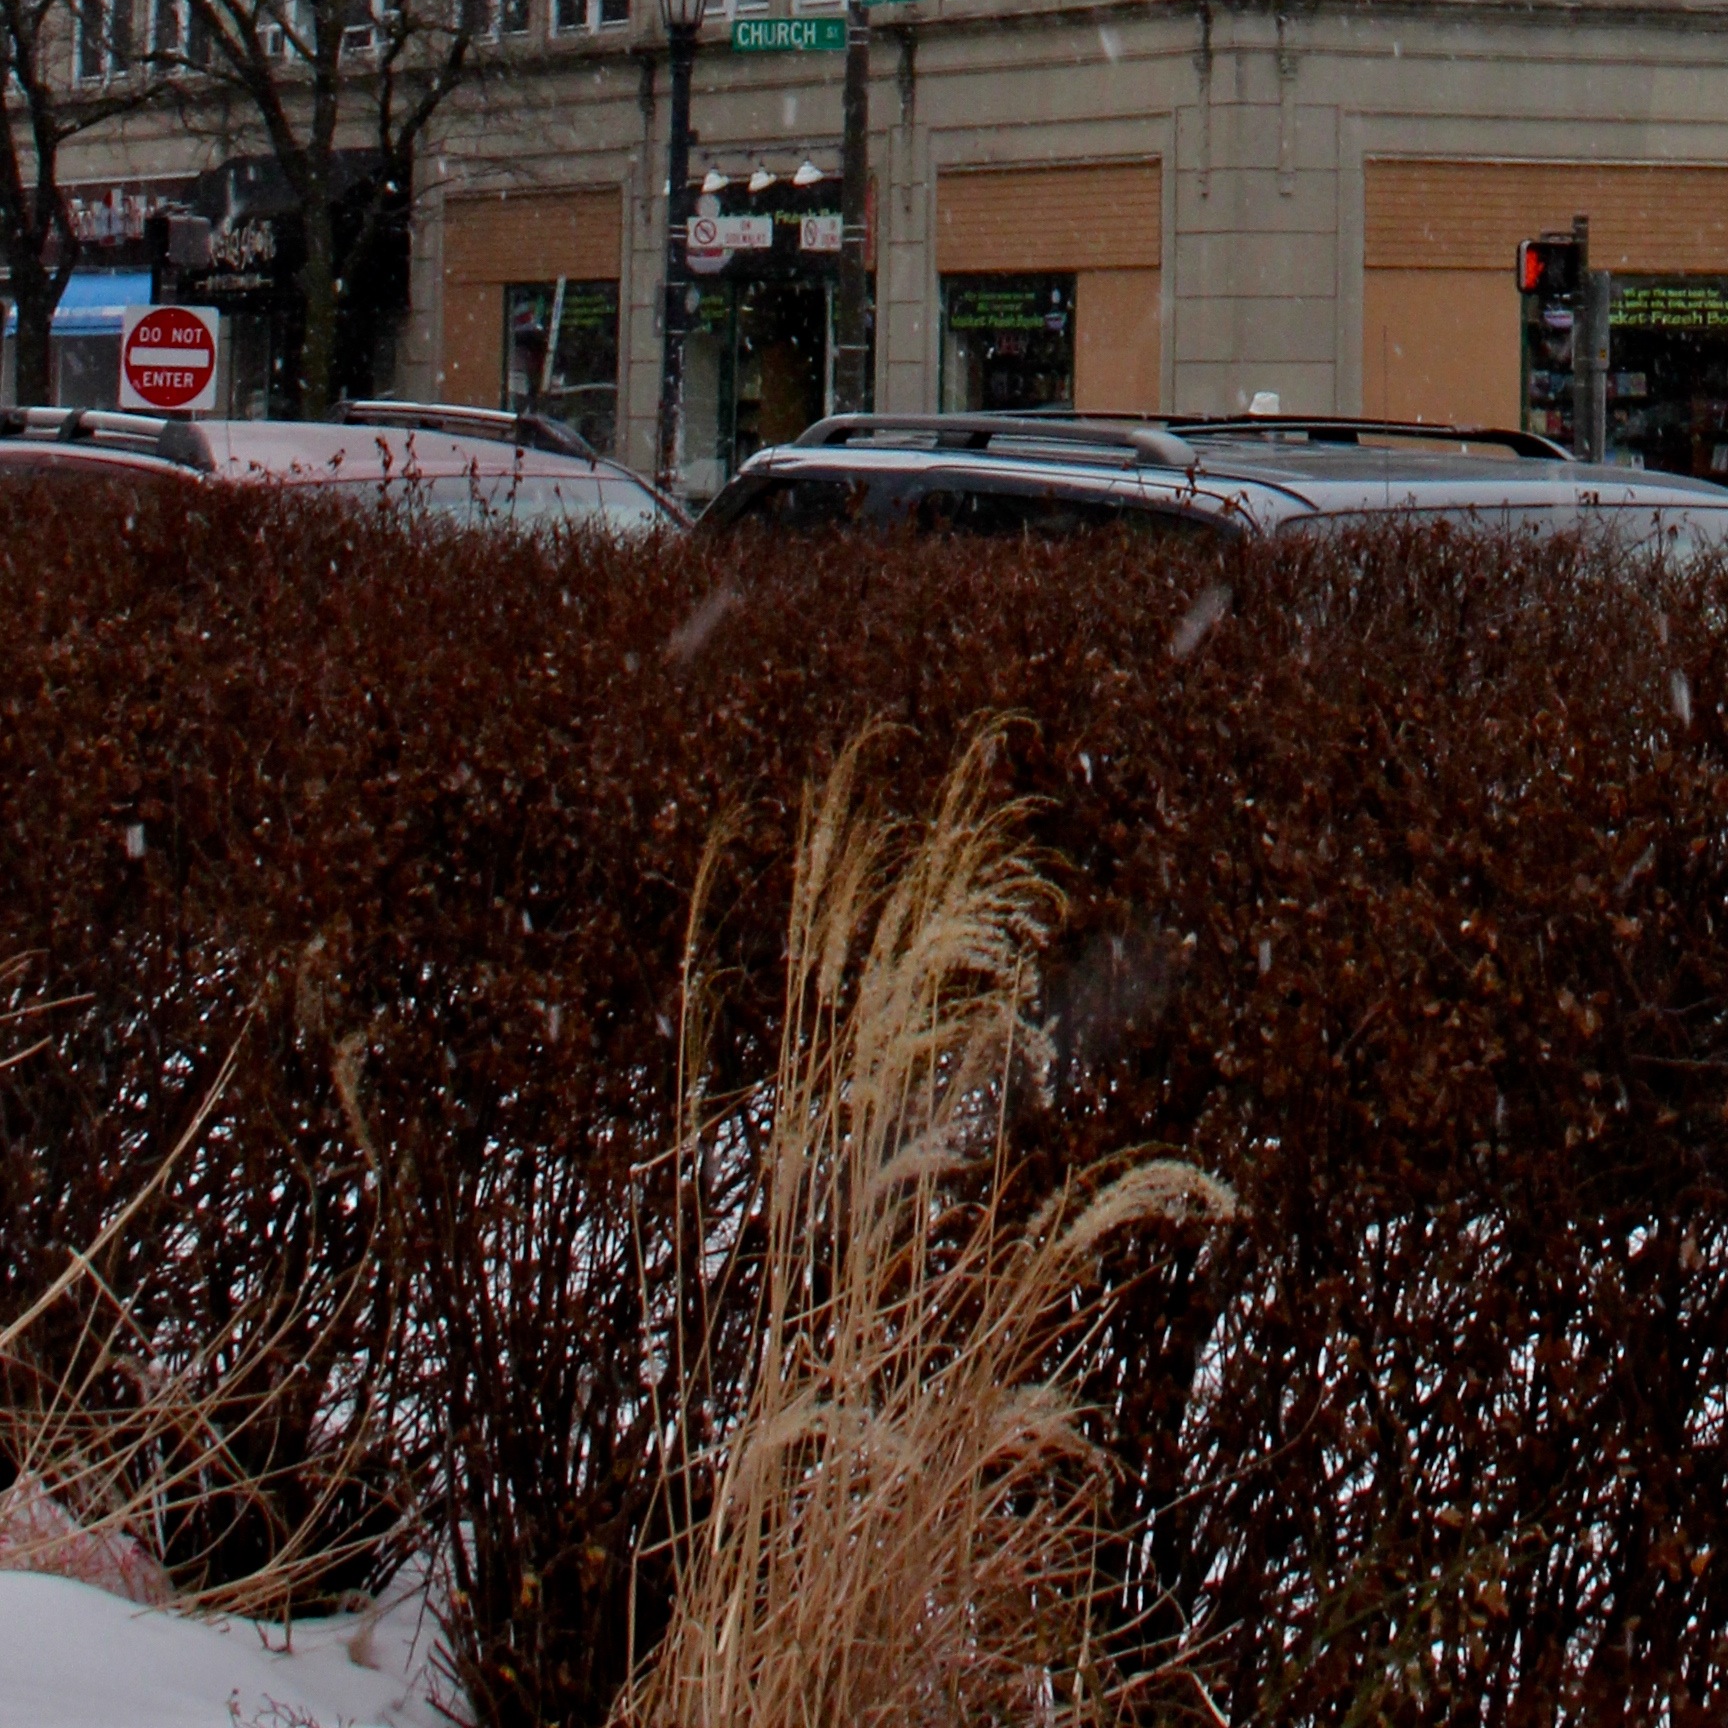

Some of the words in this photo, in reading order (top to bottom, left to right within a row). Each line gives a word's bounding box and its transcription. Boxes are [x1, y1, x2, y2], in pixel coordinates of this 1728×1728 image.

[737, 22, 817, 46] CHURCH
[1651, 311, 1703, 325] Fresh
[139, 326, 162, 342] DO
[171, 328, 203, 344] NOT
[142, 371, 194, 388] ENTER
